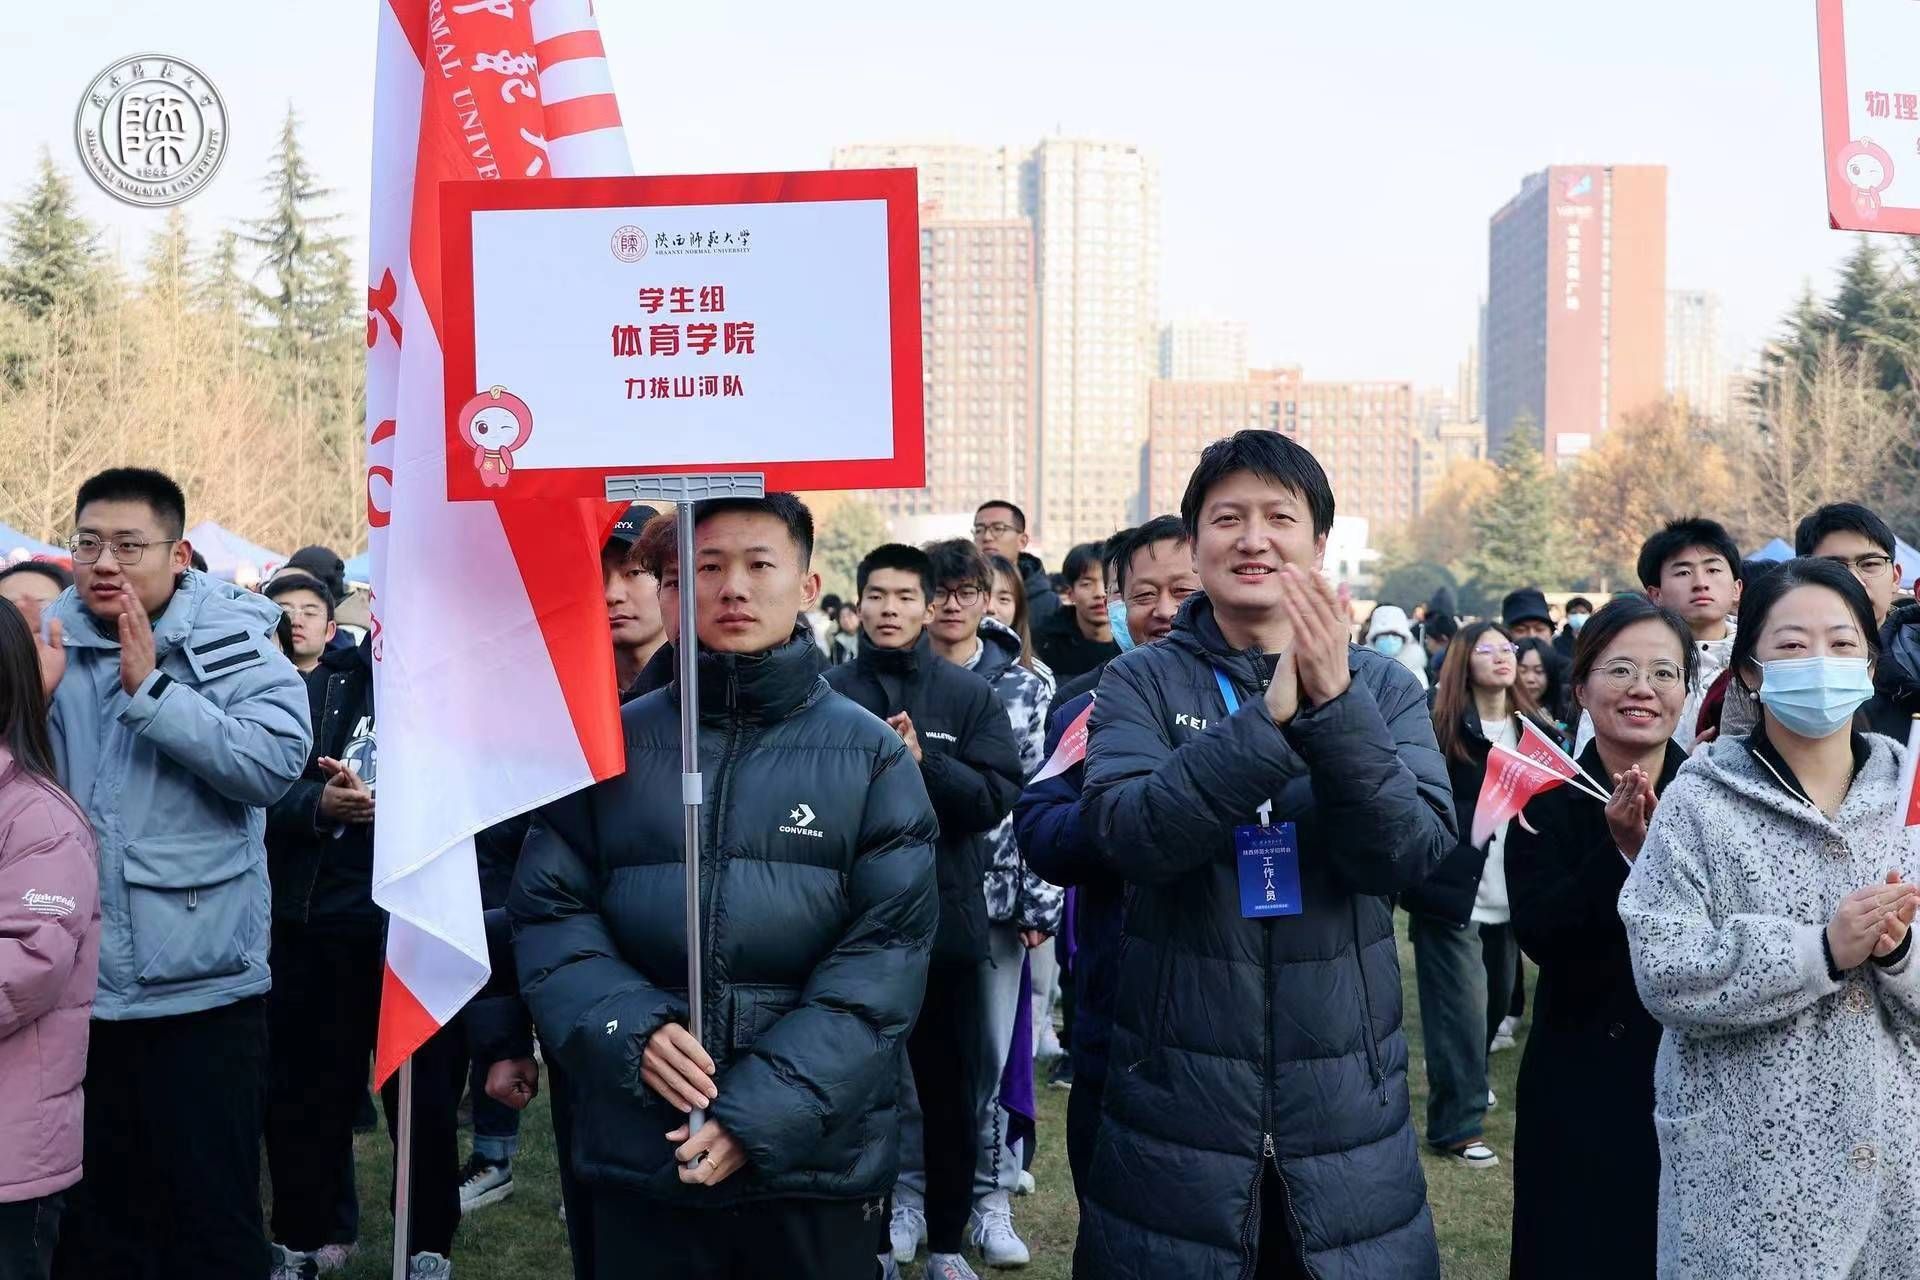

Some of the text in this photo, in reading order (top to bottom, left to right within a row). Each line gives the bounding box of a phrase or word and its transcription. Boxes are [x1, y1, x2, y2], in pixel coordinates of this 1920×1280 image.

[639, 285, 725, 314] 学生组
[611, 321, 756, 358] 体育学院
[624, 374, 744, 400] 力拔山河队
[779, 825, 824, 838] CONVERSE
[1262, 856, 1277, 902] 工作人员
